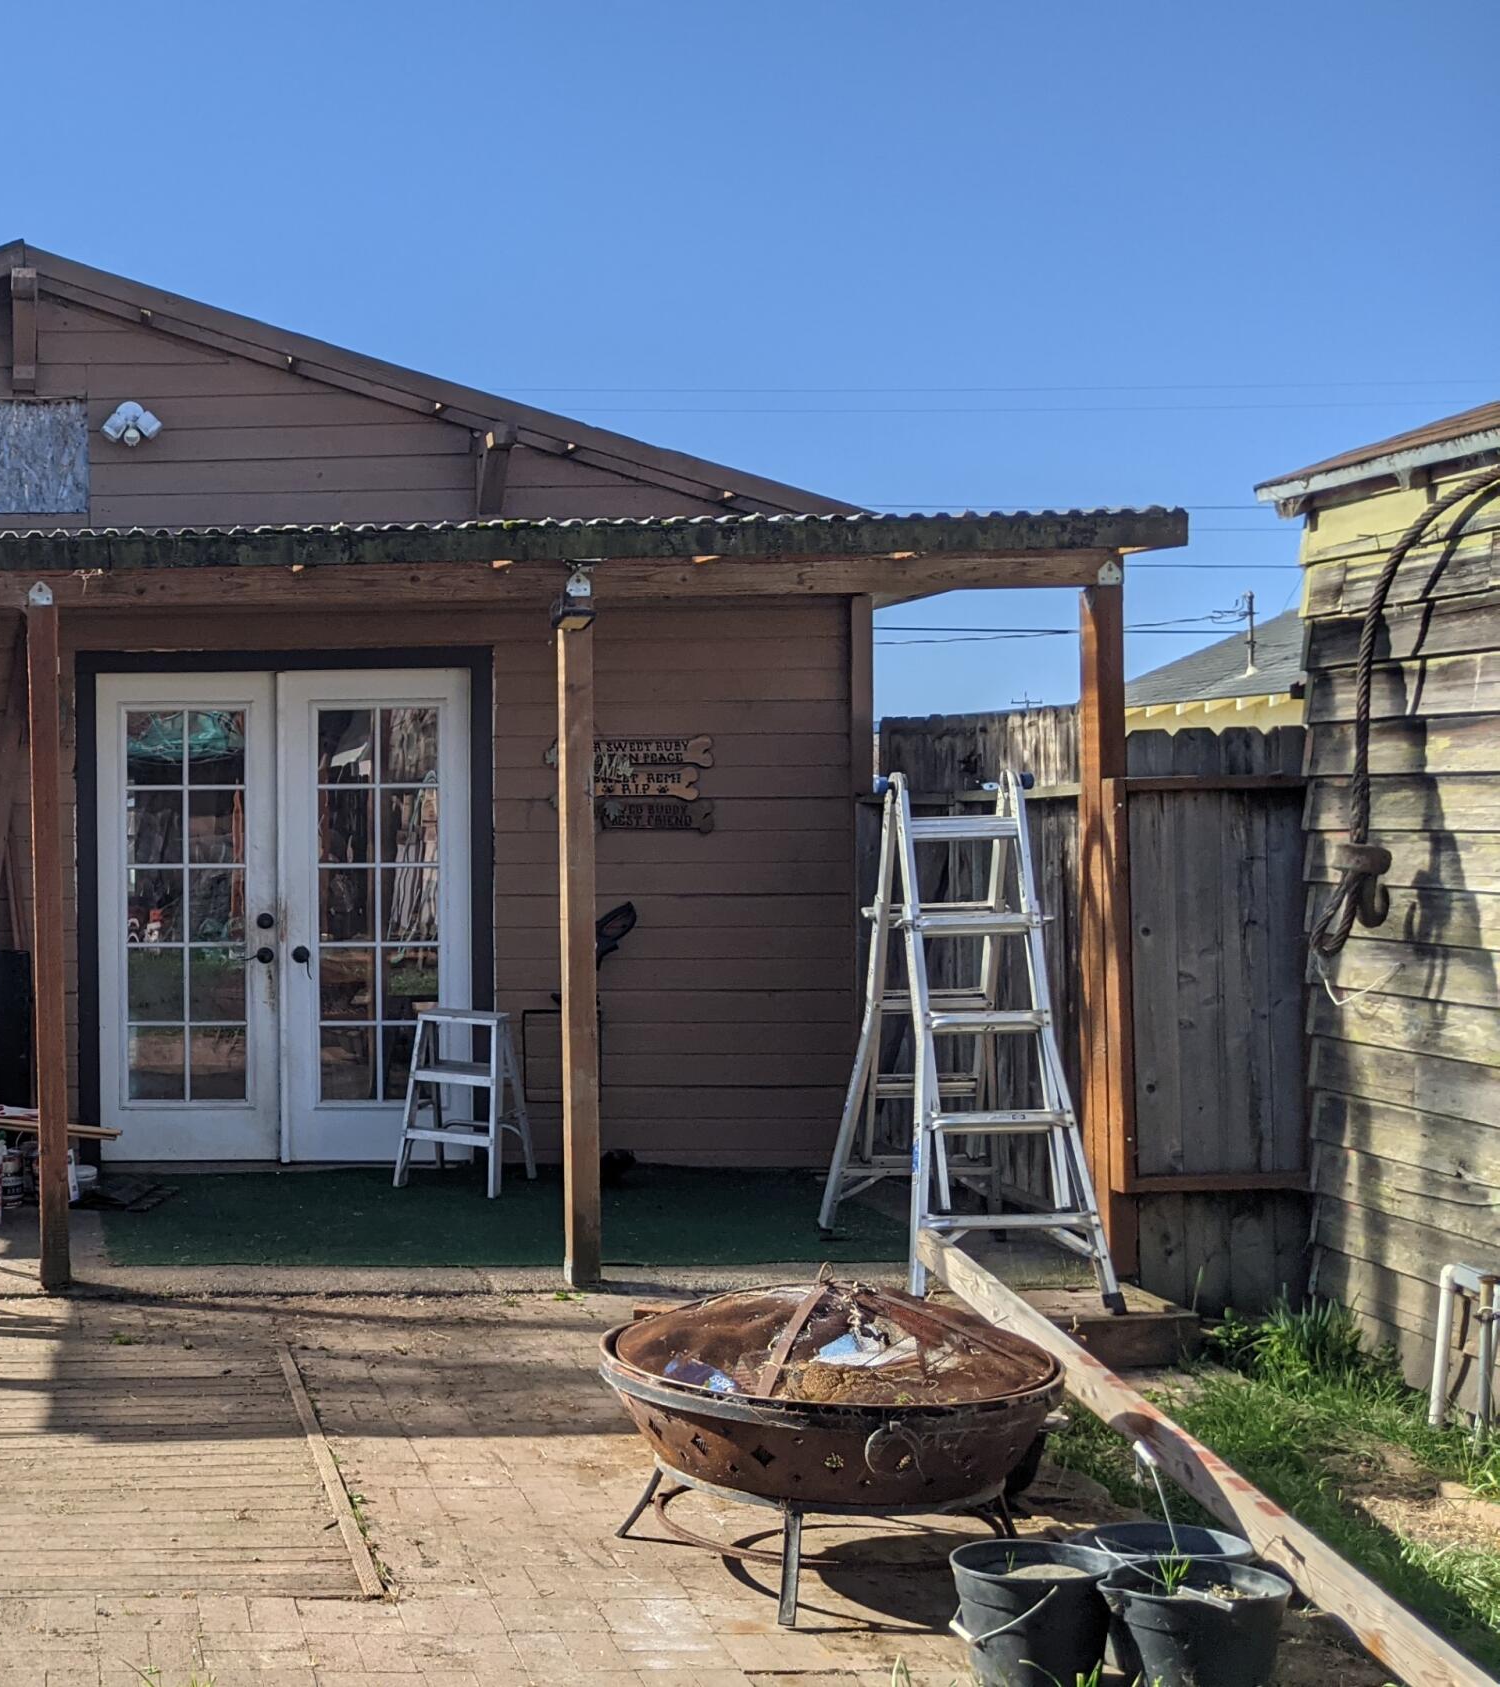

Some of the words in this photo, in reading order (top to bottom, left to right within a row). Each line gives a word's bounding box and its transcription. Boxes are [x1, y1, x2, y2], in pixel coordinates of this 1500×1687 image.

[606, 742, 652, 752] SWEET
[656, 741, 690, 752] RUBY
[643, 753, 684, 763] PEACE
[646, 773, 682, 783] REMI
[647, 815, 693, 827] FRIEND
